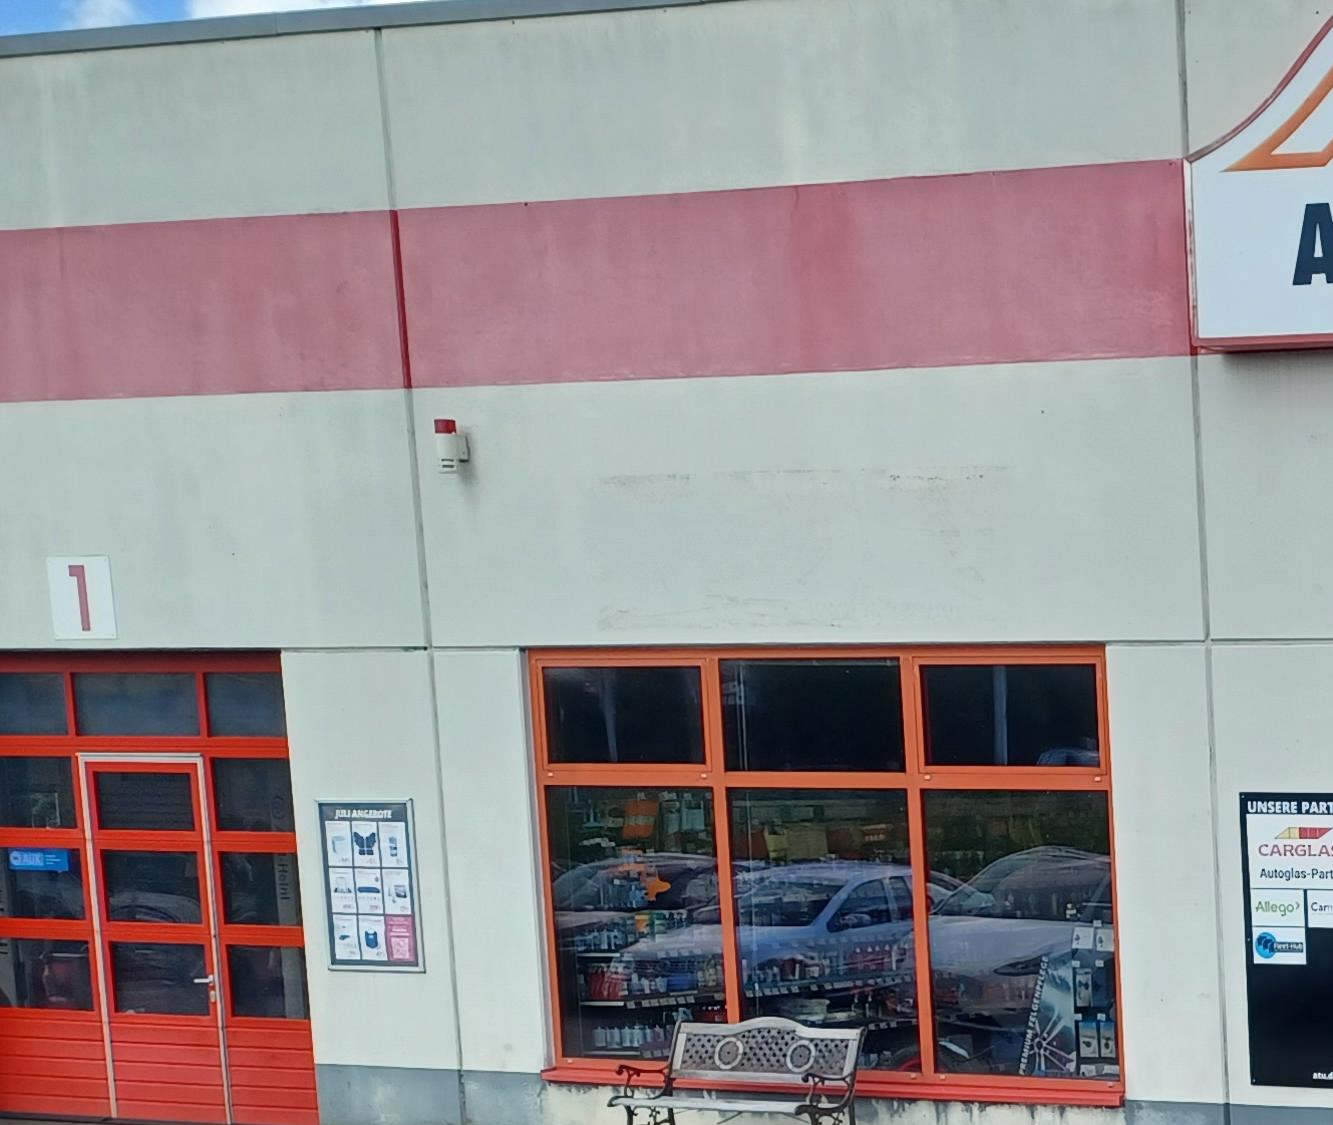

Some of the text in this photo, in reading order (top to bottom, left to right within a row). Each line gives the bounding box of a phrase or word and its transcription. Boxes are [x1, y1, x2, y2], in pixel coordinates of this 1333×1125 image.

[68, 565, 91, 631] 1
[1247, 800, 1298, 814] UNSERE
[1255, 900, 1296, 917] Allego
[1018, 955, 1050, 1077] PREMIUM FELGENPFLEGE
